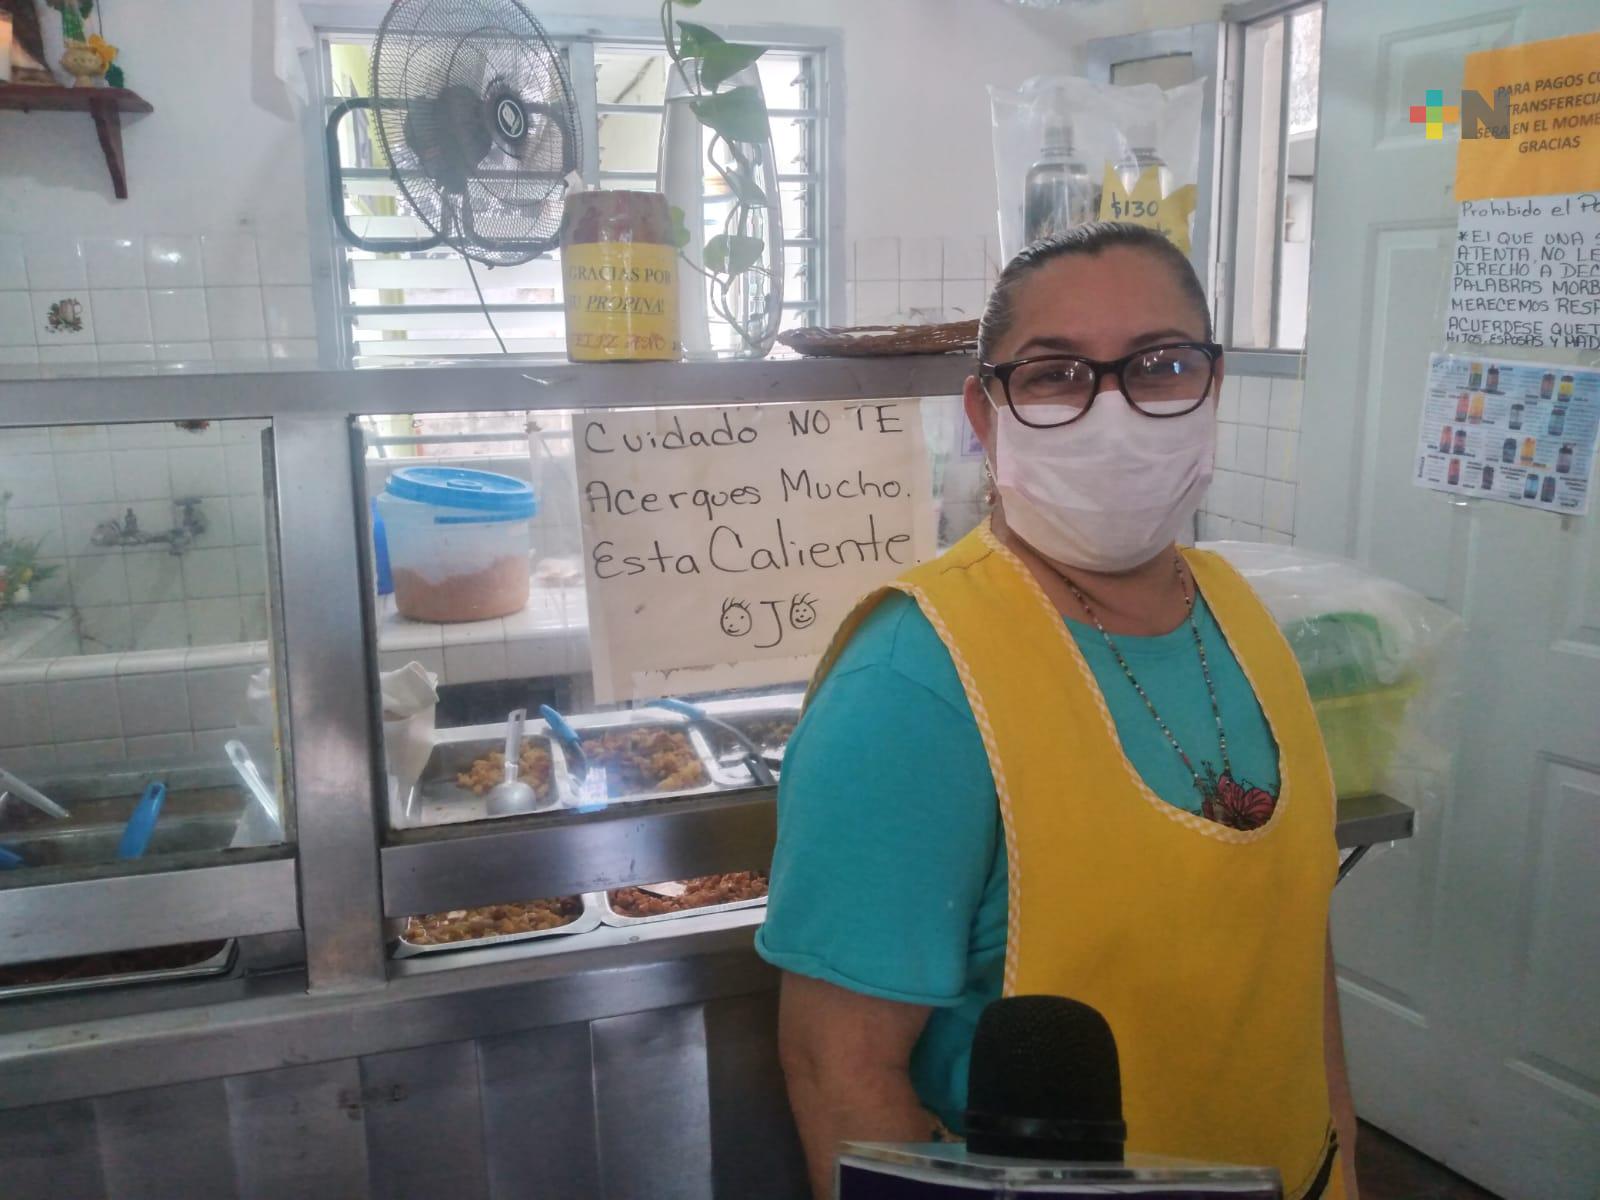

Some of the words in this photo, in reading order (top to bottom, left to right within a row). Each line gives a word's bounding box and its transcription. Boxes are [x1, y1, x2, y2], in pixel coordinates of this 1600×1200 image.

[1497, 81, 1530, 96] PARA
[1535, 73, 1583, 91] PAGOS
[1513, 122, 1529, 135] EN
[1534, 120, 1548, 131] EL
[1552, 113, 1600, 129] MOME
[1519, 136, 1581, 154] GRACIAS
[1111, 192, 1158, 219] $130
[1462, 200, 1541, 217] Prohibido
[1551, 198, 1570, 216] el
[1497, 232, 1534, 245] QUE
[1545, 232, 1584, 246] UNA
[1541, 246, 1565, 261] NO
[569, 264, 640, 281] GRACIAS
[1455, 261, 1529, 276] DERECHO
[1540, 264, 1551, 277] A
[1454, 277, 1542, 294] PALABRAS
[1452, 298, 1549, 312] MERECEMOS
[1449, 317, 1543, 335] ACUERDESE
[1490, 332, 1543, 347] ESPOSAS
[1550, 336, 1558, 347] Y
[585, 412, 758, 453] Cuidado
[788, 409, 830, 437] NO
[844, 404, 904, 433] TE
[585, 480, 761, 520] Acerques
[781, 468, 910, 501] Mucho.
[593, 541, 700, 579] Esta
[709, 514, 921, 572] Caliente.
[720, 593, 819, 648] OJO
